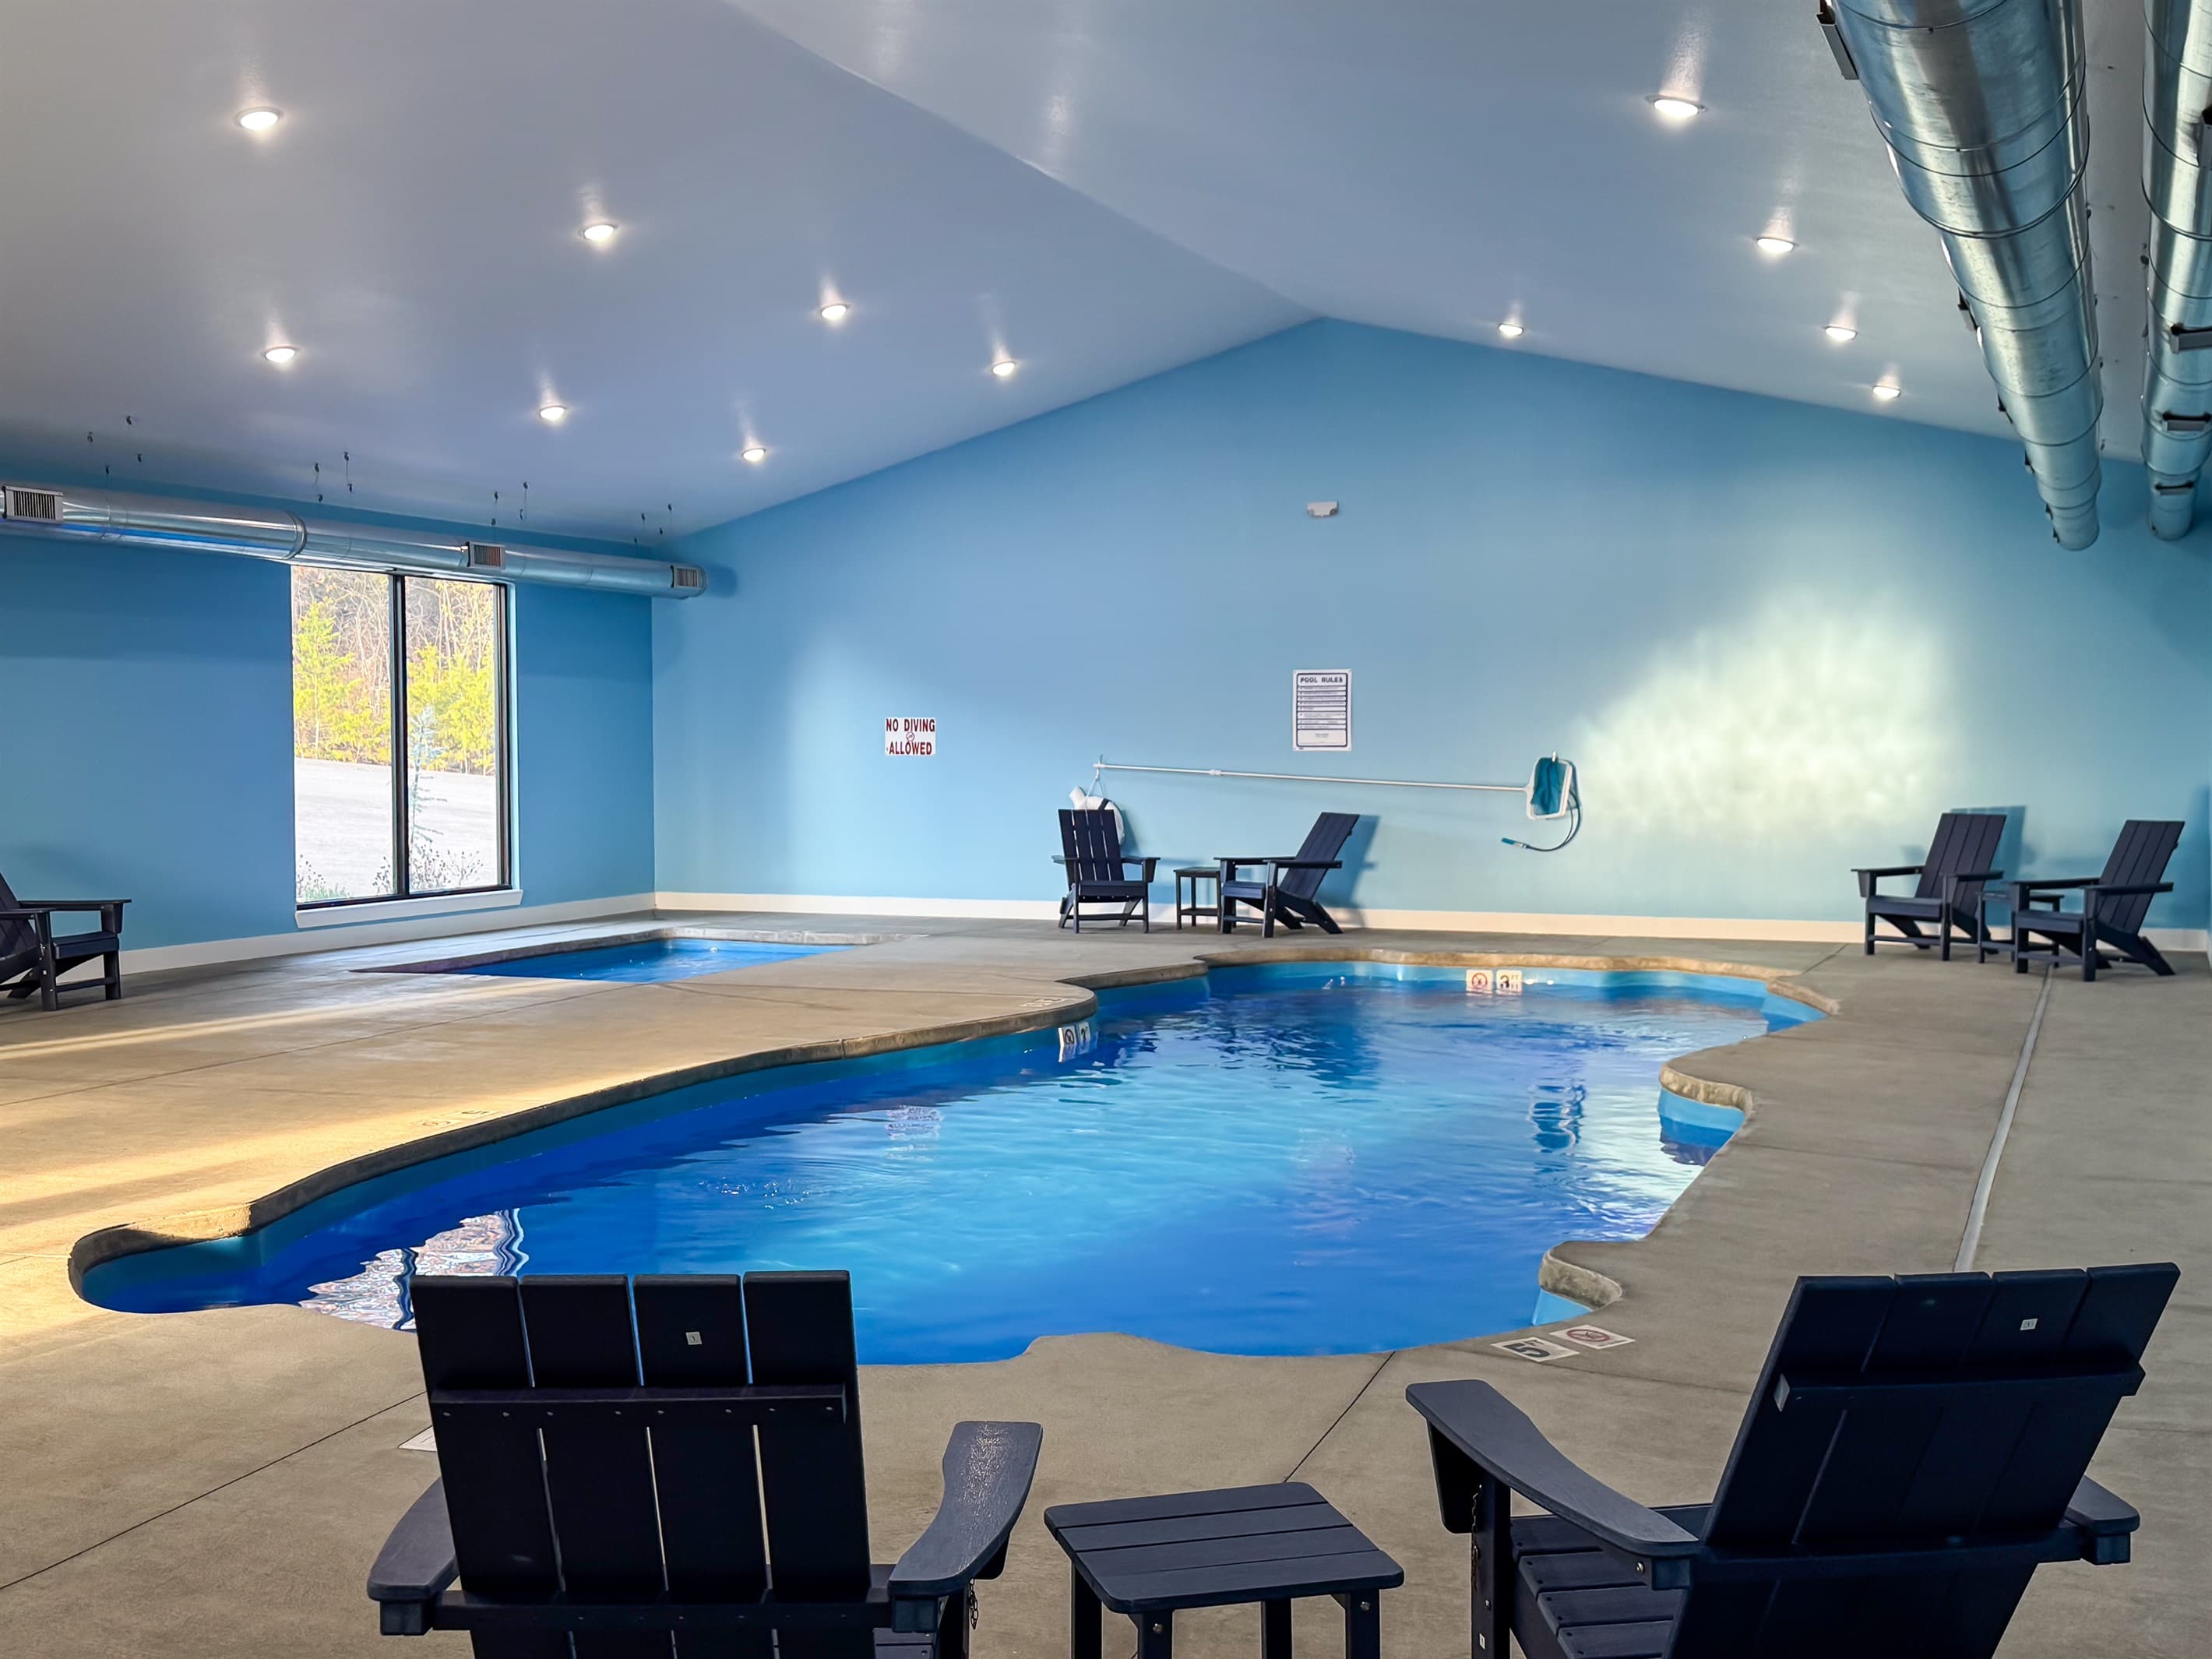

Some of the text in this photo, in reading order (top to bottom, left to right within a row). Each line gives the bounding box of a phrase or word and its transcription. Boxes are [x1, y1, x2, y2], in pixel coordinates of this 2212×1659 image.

[886, 718, 935, 732] NO DIVING
[889, 741, 932, 755] ALLOWED
[1503, 1343, 1551, 1358] 5
